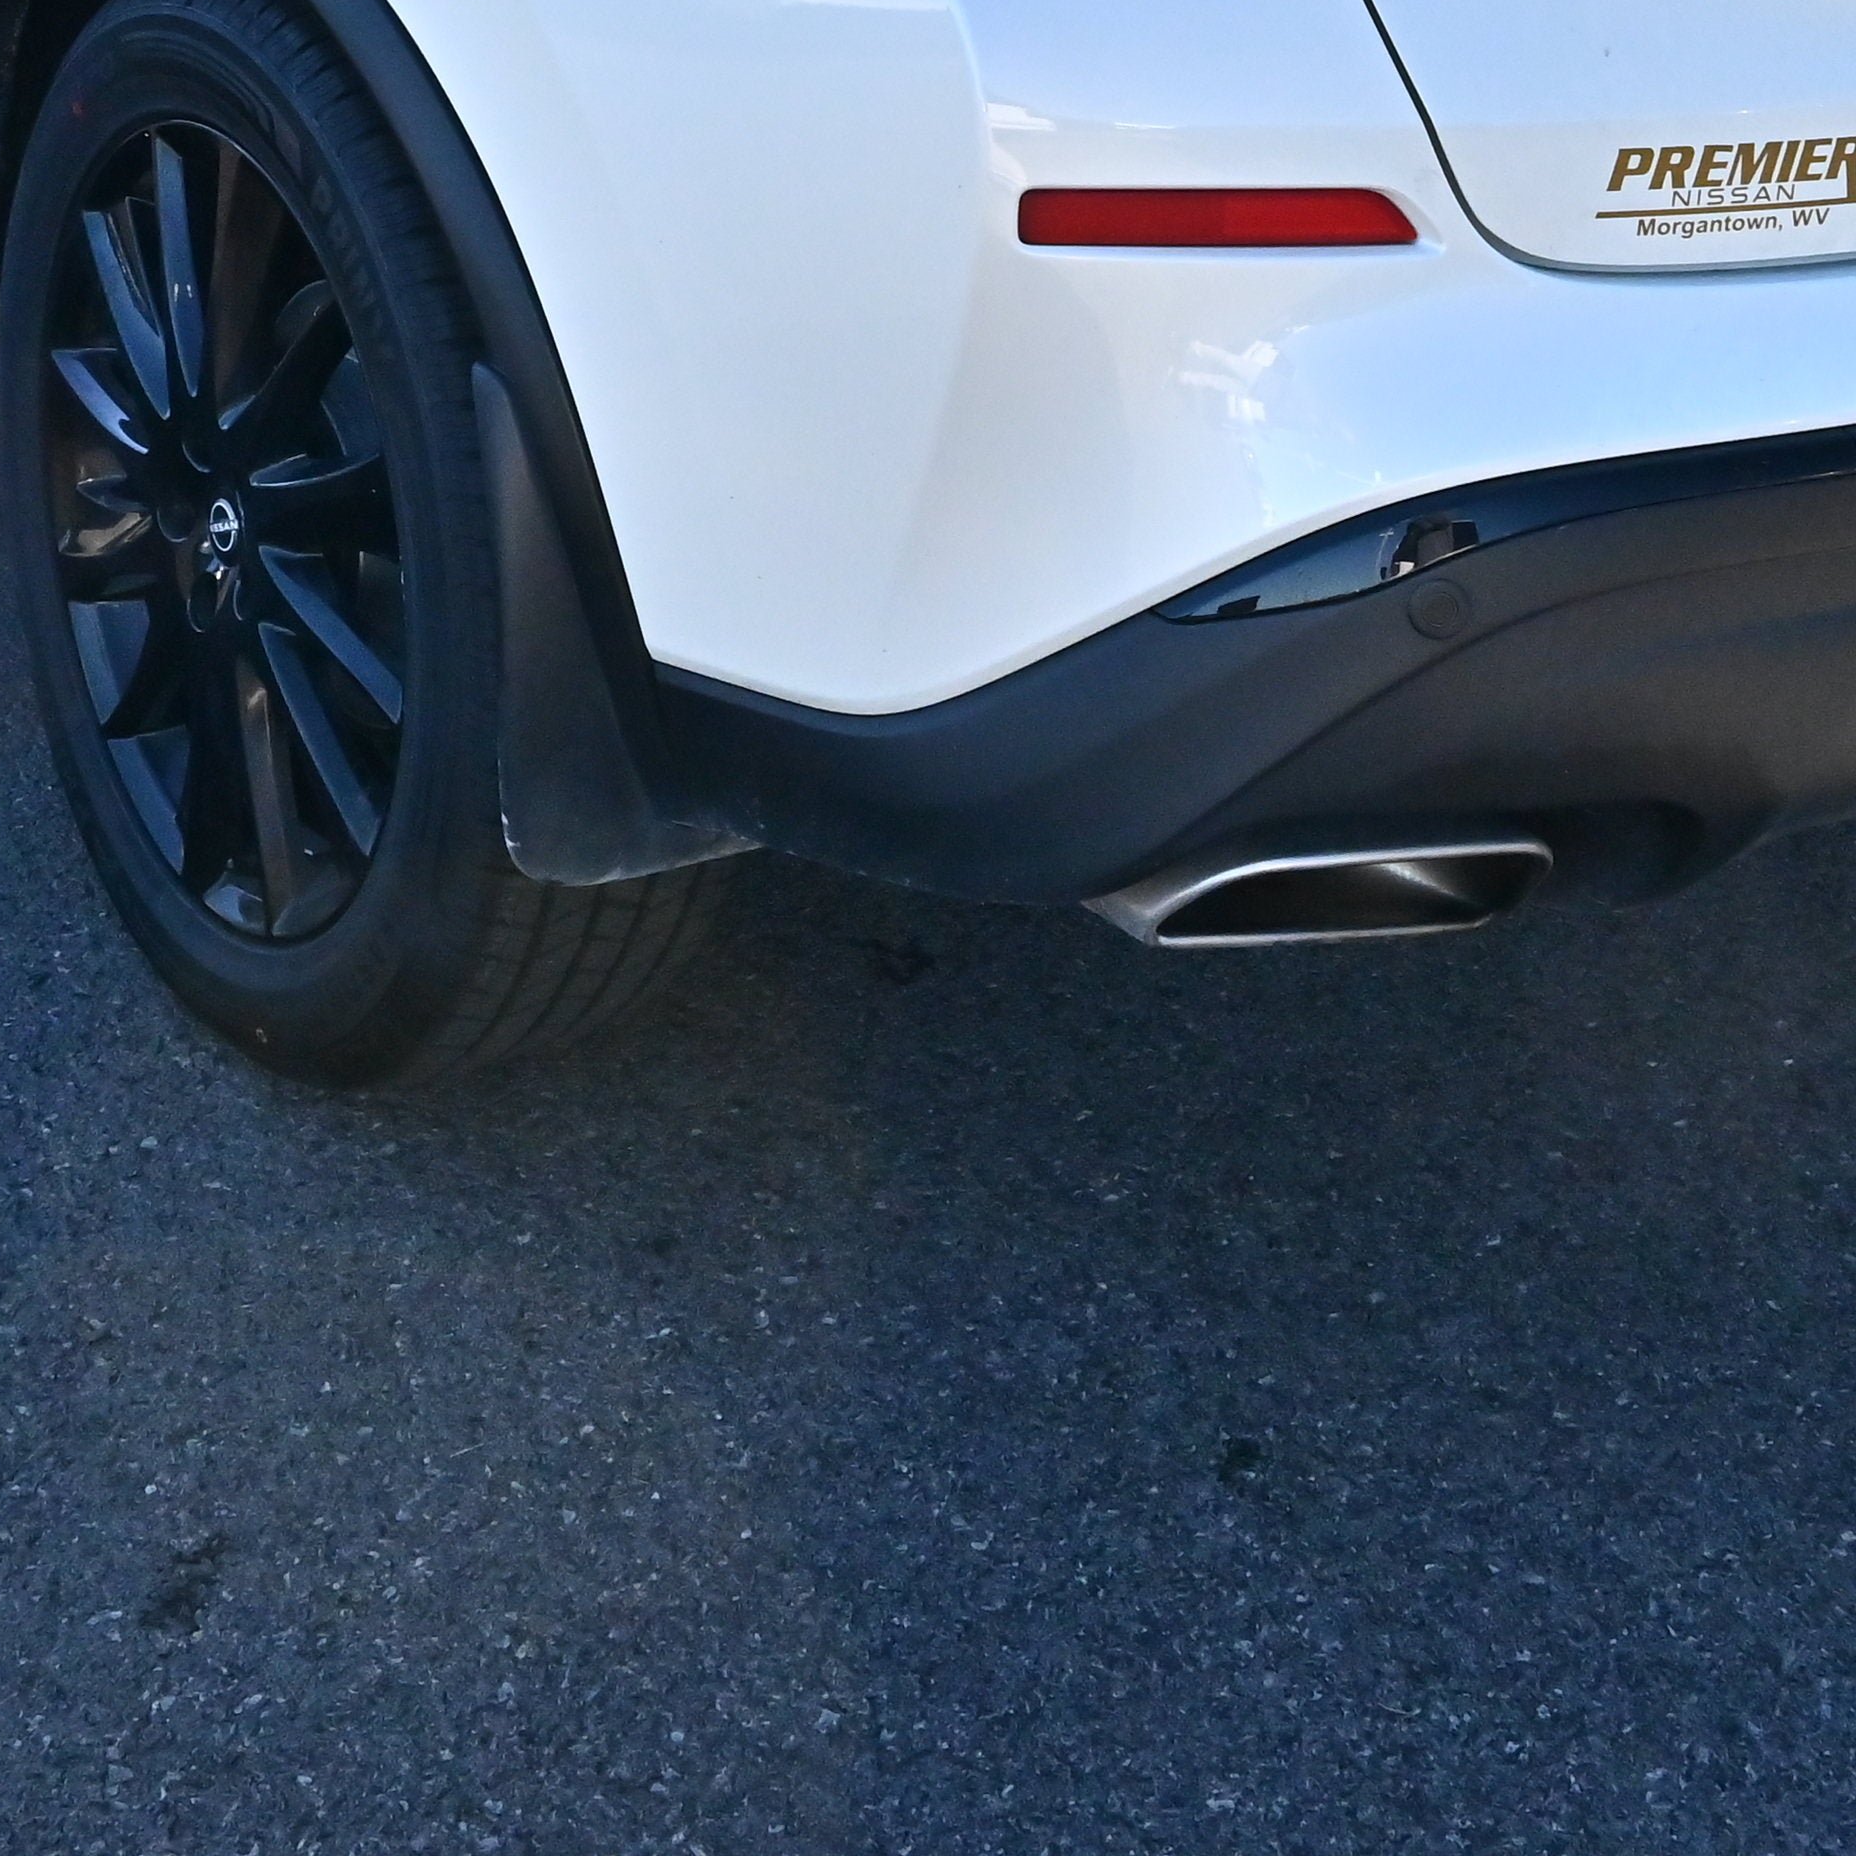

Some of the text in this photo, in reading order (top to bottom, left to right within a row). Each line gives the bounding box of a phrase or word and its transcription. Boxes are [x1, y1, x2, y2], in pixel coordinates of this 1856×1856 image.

[1671, 184, 1795, 207] NISSAN
[1636, 208, 1830, 239] Morgantown, WV
